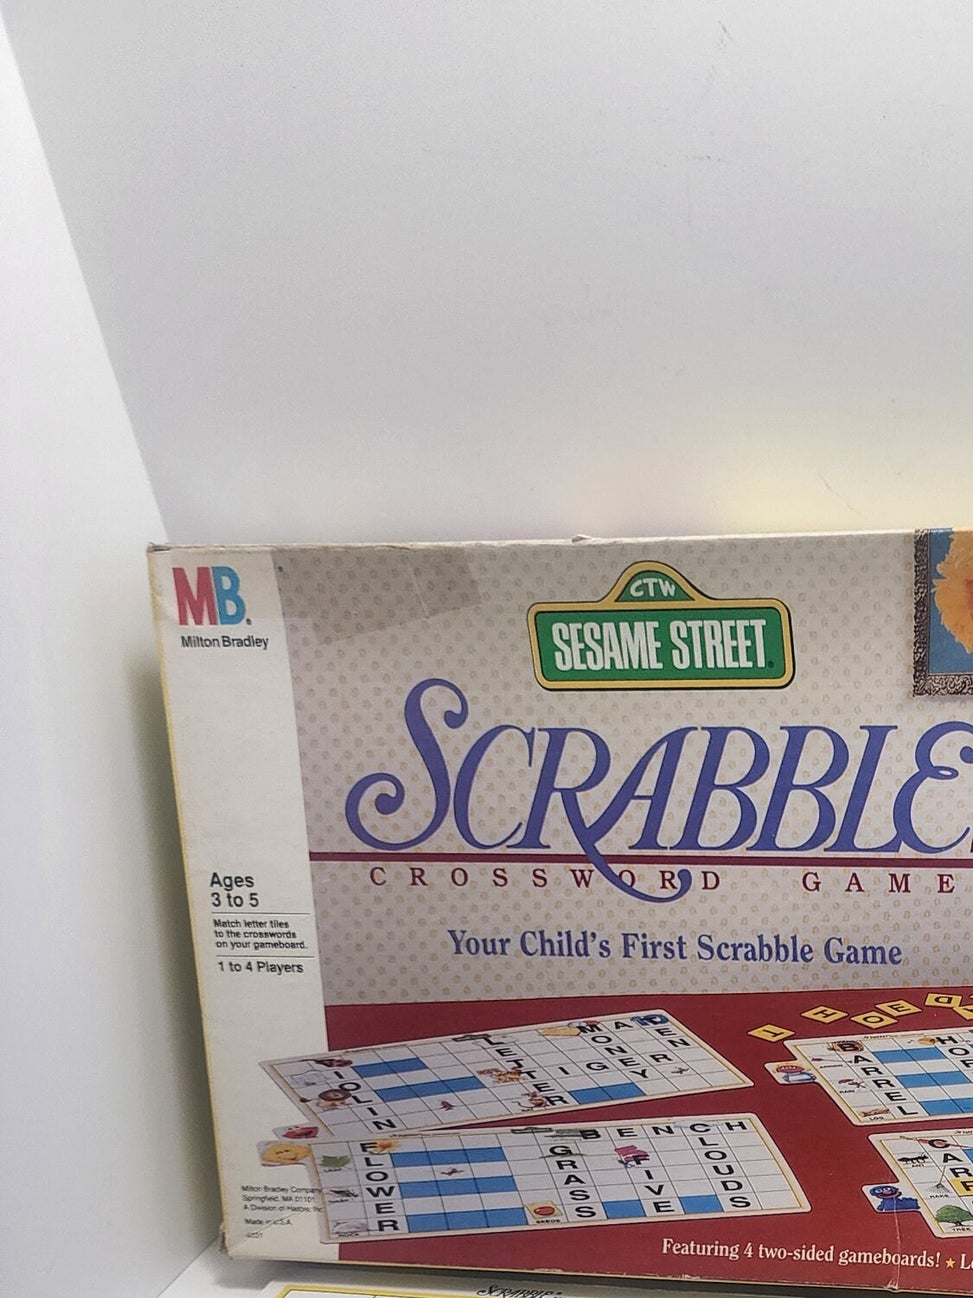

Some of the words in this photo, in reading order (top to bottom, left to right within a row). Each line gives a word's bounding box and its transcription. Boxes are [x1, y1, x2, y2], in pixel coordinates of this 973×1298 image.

[172, 566, 246, 625] MB
[630, 578, 676, 597] CTW
[181, 636, 219, 648] Milton
[221, 635, 269, 651] Bradley
[551, 621, 663, 672] SESAME
[669, 619, 766, 669] STREET
[210, 872, 254, 891] Ages
[369, 867, 722, 892] CROSSWORD
[802, 873, 956, 894] GAME
[211, 892, 221, 907] 3
[227, 893, 244, 907] to
[249, 892, 259, 907] 5
[213, 919, 241, 928] Match
[244, 919, 267, 928] letter
[270, 920, 289, 929] tiles
[214, 930, 224, 938] to
[227, 930, 241, 938] the
[243, 930, 297, 939] crosswords
[216, 941, 228, 949] on
[230, 941, 251, 950] your
[446, 929, 512, 959] Your
[519, 931, 612, 960] Child's
[620, 934, 688, 961] First
[696, 934, 815, 963] Scrabble
[824, 939, 902, 965] Game
[218, 961, 224, 971] 1
[229, 961, 242, 972] to
[245, 961, 253, 972] 4
[256, 961, 304, 975] Players
[661, 1238, 739, 1260] Featuring
[743, 1243, 753, 1258] 4
[758, 1244, 834, 1263] two-sided
[838, 1247, 941, 1269] gameboards!
